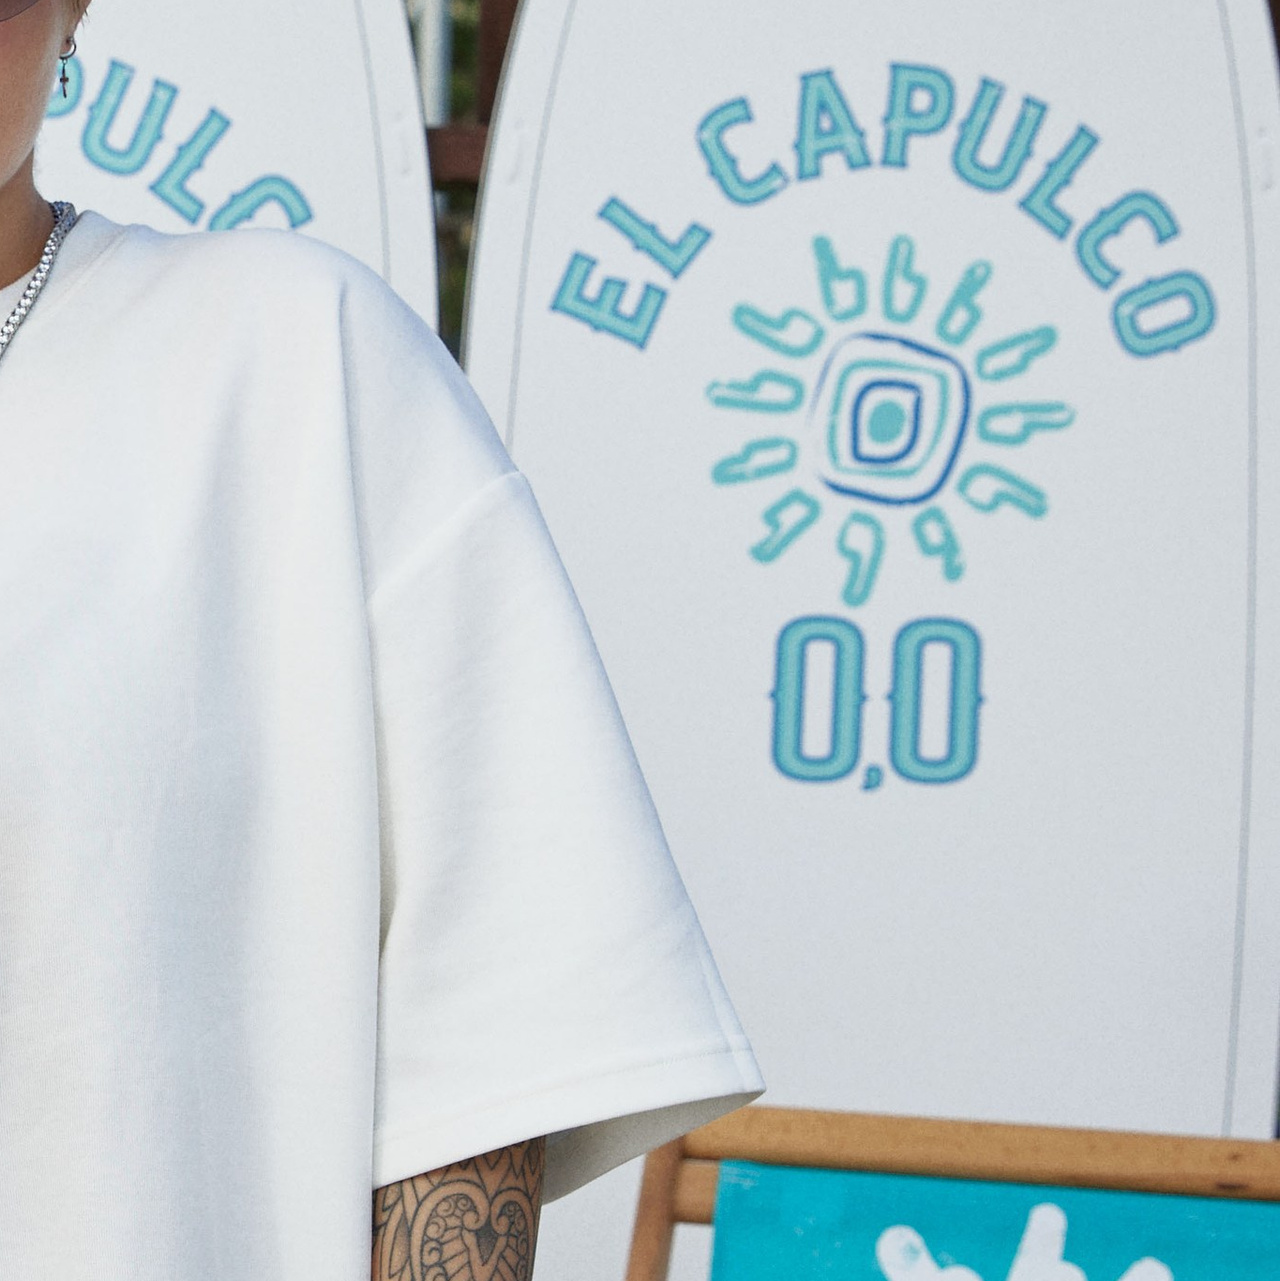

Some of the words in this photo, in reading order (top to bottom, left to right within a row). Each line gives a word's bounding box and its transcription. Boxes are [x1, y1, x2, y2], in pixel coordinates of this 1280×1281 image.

[549, 194, 713, 351] EL
[696, 61, 1217, 358] CAPULCO
[770, 614, 985, 791] 0,0
